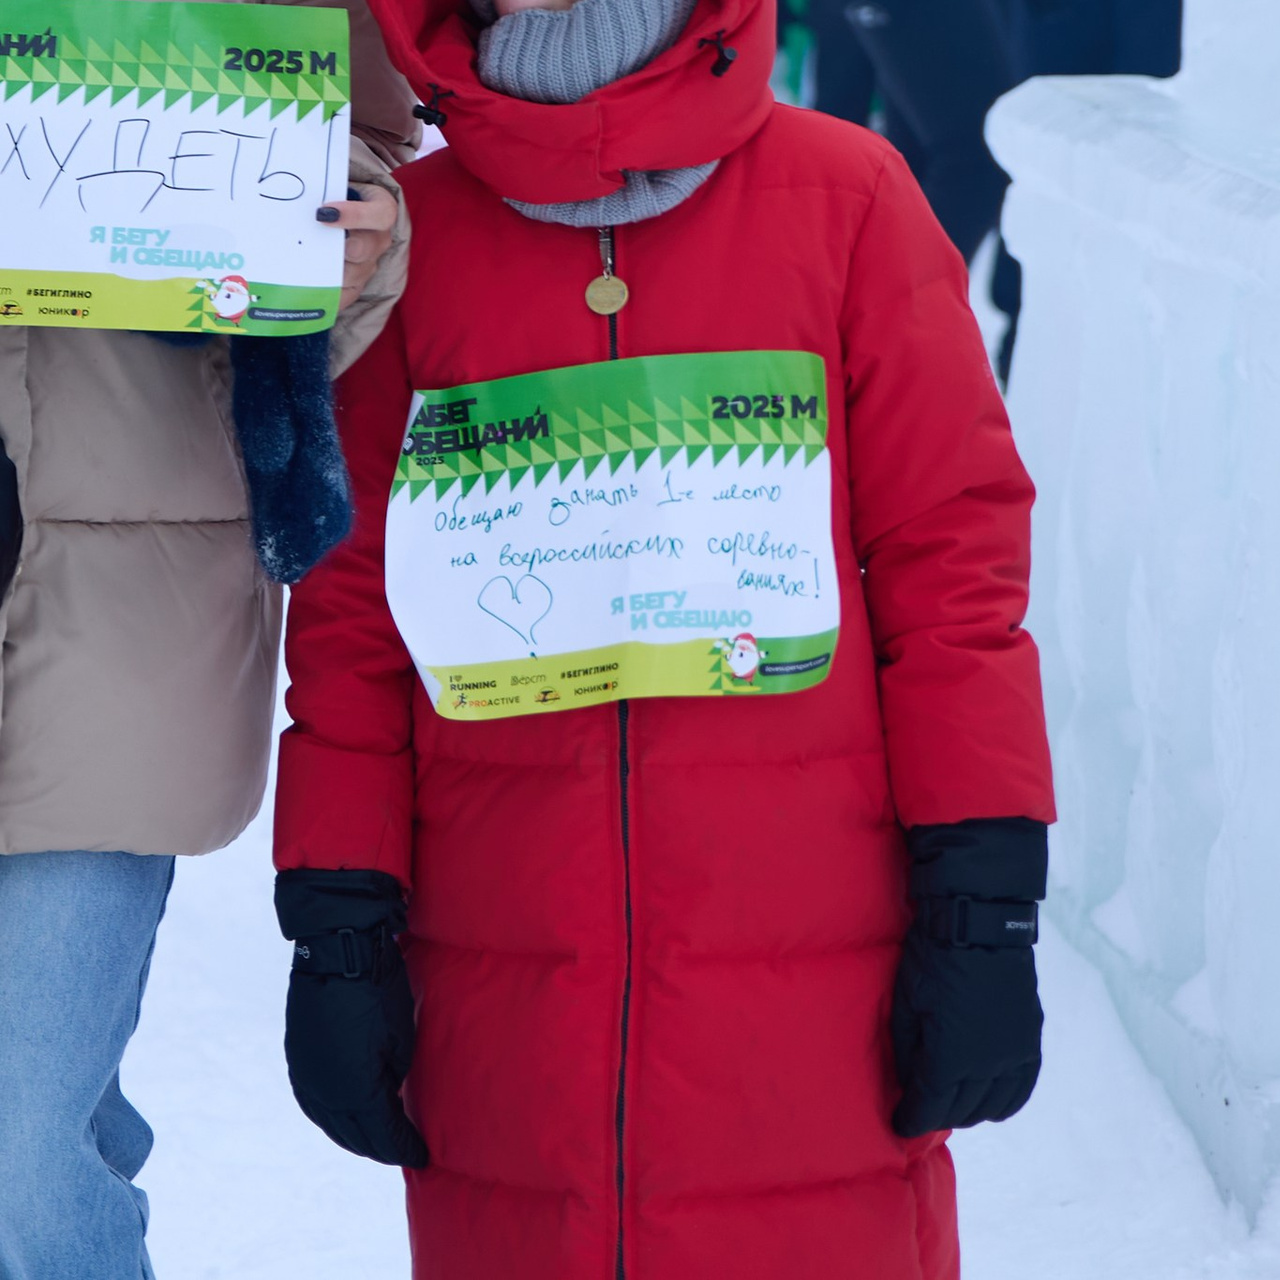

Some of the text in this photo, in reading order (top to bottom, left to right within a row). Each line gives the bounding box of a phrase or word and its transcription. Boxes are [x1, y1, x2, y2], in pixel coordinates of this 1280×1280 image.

[225, 47, 303, 74] 2025
[89, 226, 171, 248] Я БЕГУ
[110, 246, 244, 271] И ОБЕЩАЮ
[26, 288, 92, 299] #БЕГИГЛИНО
[411, 397, 477, 428] АБЕГ
[711, 395, 785, 420] 2025
[416, 456, 445, 466] 2025
[451, 552, 478, 568] на
[610, 590, 687, 615] Я БЕГУ
[630, 609, 753, 630] И ОБЕЩАЮ
[450, 681, 497, 691] RUNNING
